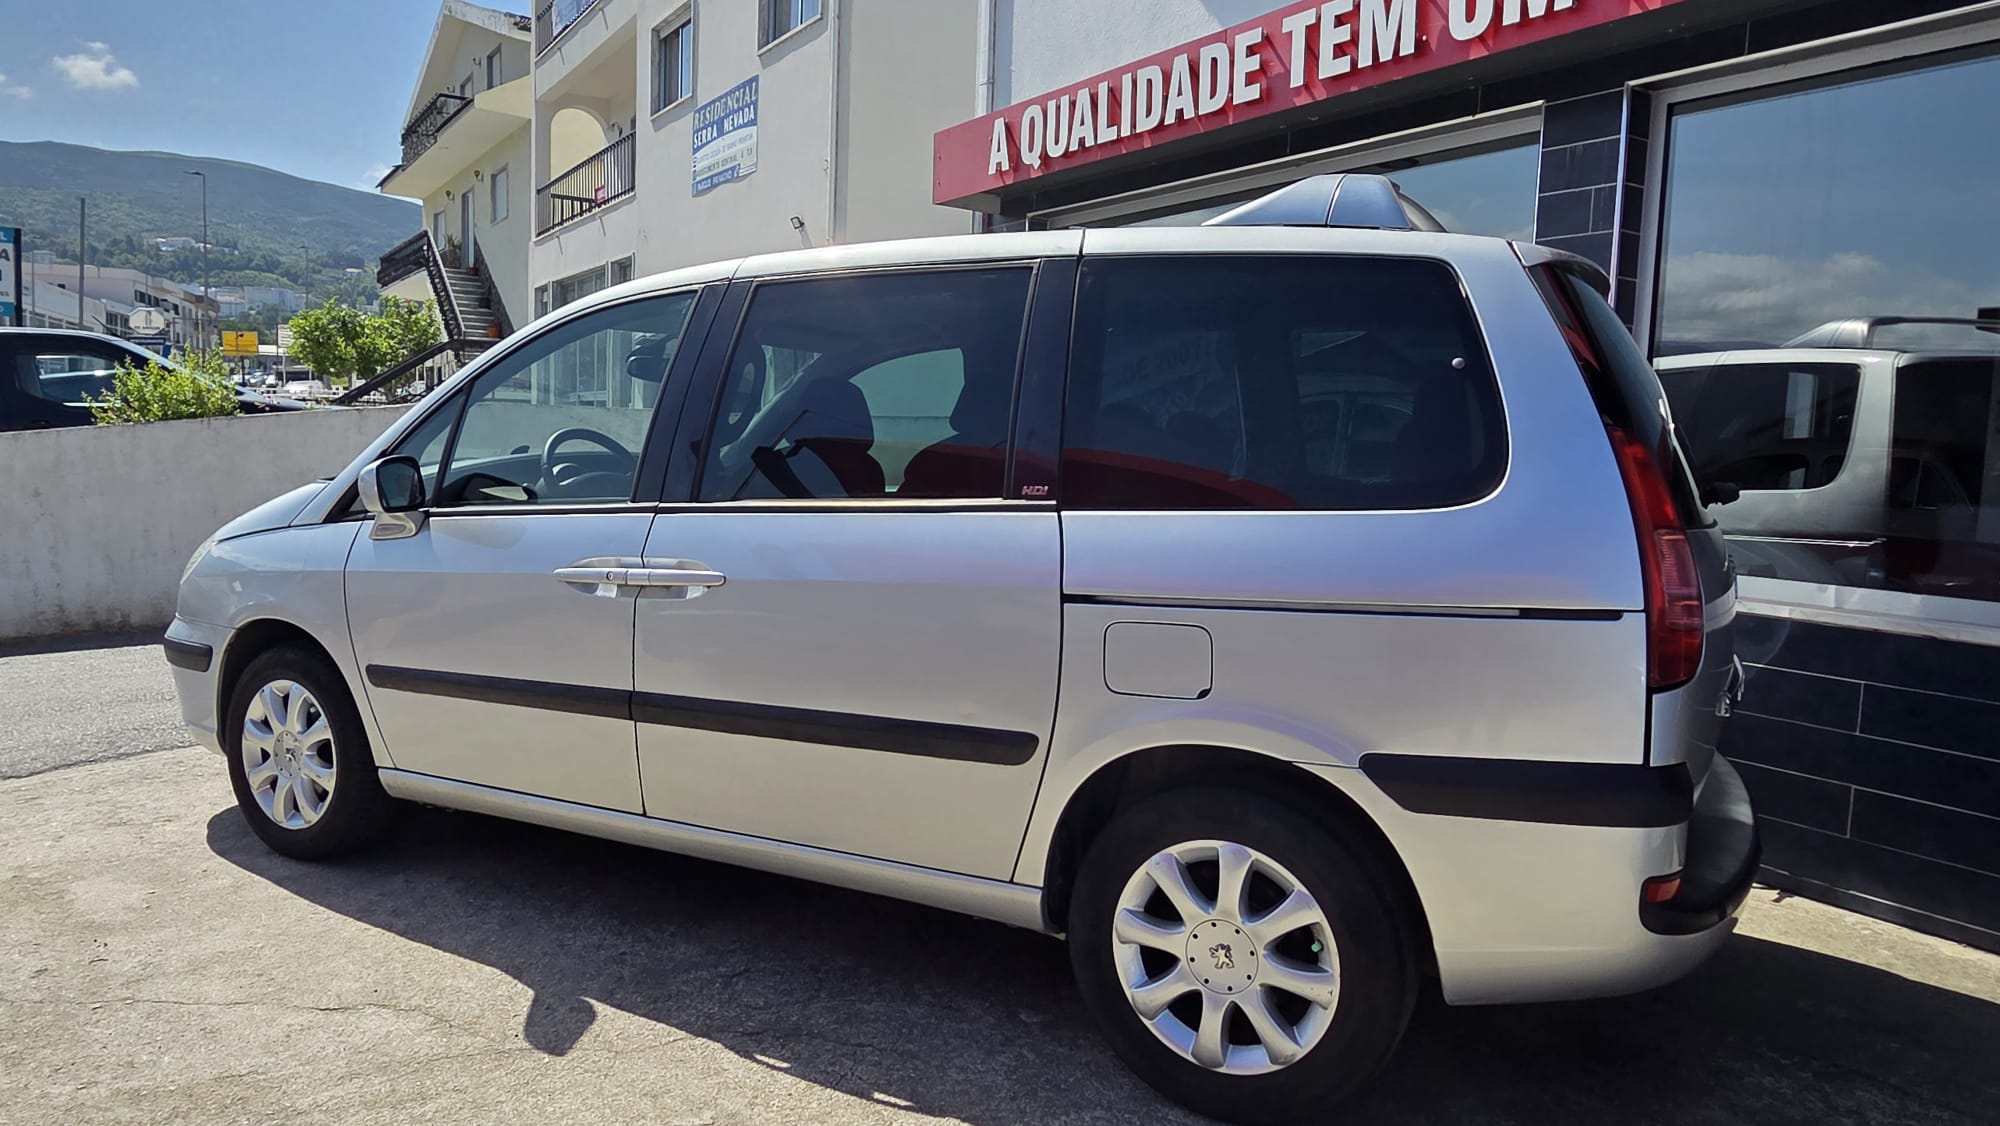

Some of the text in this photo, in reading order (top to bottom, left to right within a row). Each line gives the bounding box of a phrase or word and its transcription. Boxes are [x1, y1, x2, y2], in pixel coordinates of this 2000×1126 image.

[694, 82, 757, 129] RESIDENCIAL
[988, 117, 1010, 175] A
[1020, 27, 1262, 170] QUALIDADE
[1282, 0, 1417, 89] TEM
[693, 124, 718, 149] SERRA
[723, 104, 755, 134] NEVADA
